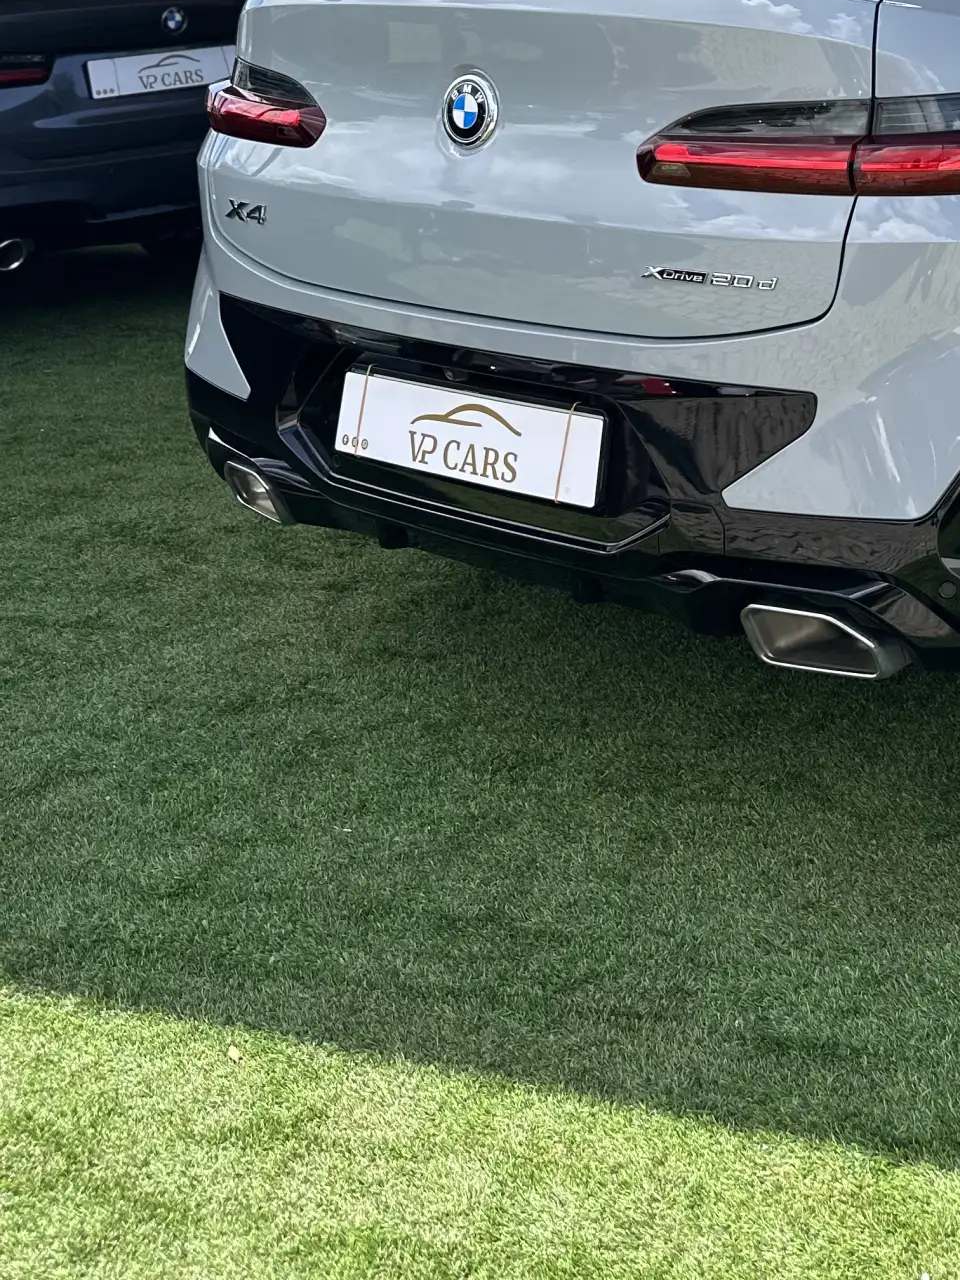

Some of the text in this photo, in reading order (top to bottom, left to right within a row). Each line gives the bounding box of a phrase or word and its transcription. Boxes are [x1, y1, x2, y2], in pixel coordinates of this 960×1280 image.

[138, 69, 204, 90] VP CARS
[225, 197, 267, 225] X4
[408, 430, 518, 484] VP CARS
